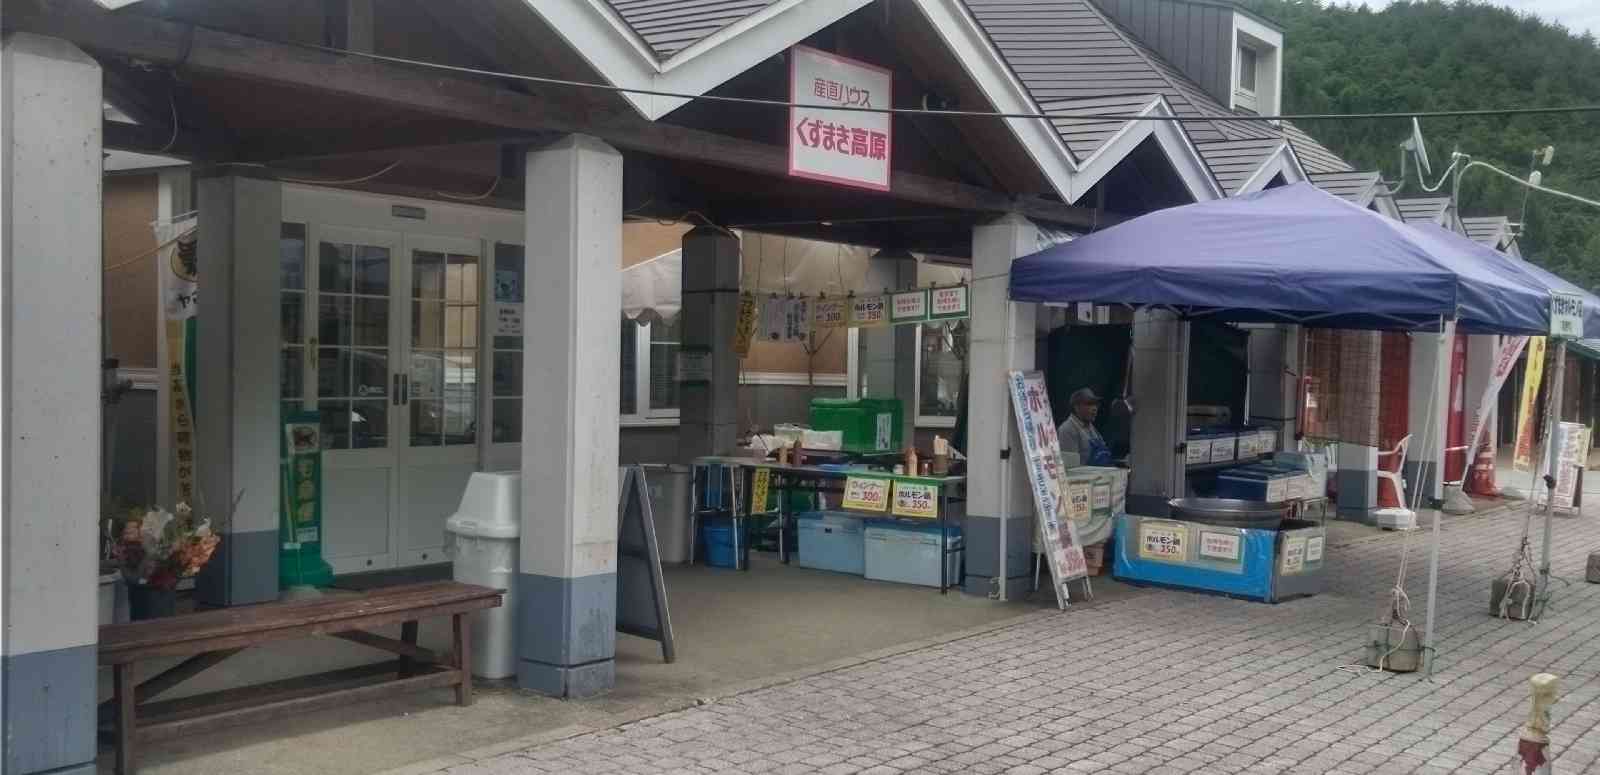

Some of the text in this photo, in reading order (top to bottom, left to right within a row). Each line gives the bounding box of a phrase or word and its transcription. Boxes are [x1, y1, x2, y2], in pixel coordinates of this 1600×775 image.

[813, 77, 872, 108] 産直ハウス
[795, 116, 888, 161] くずまき高原
